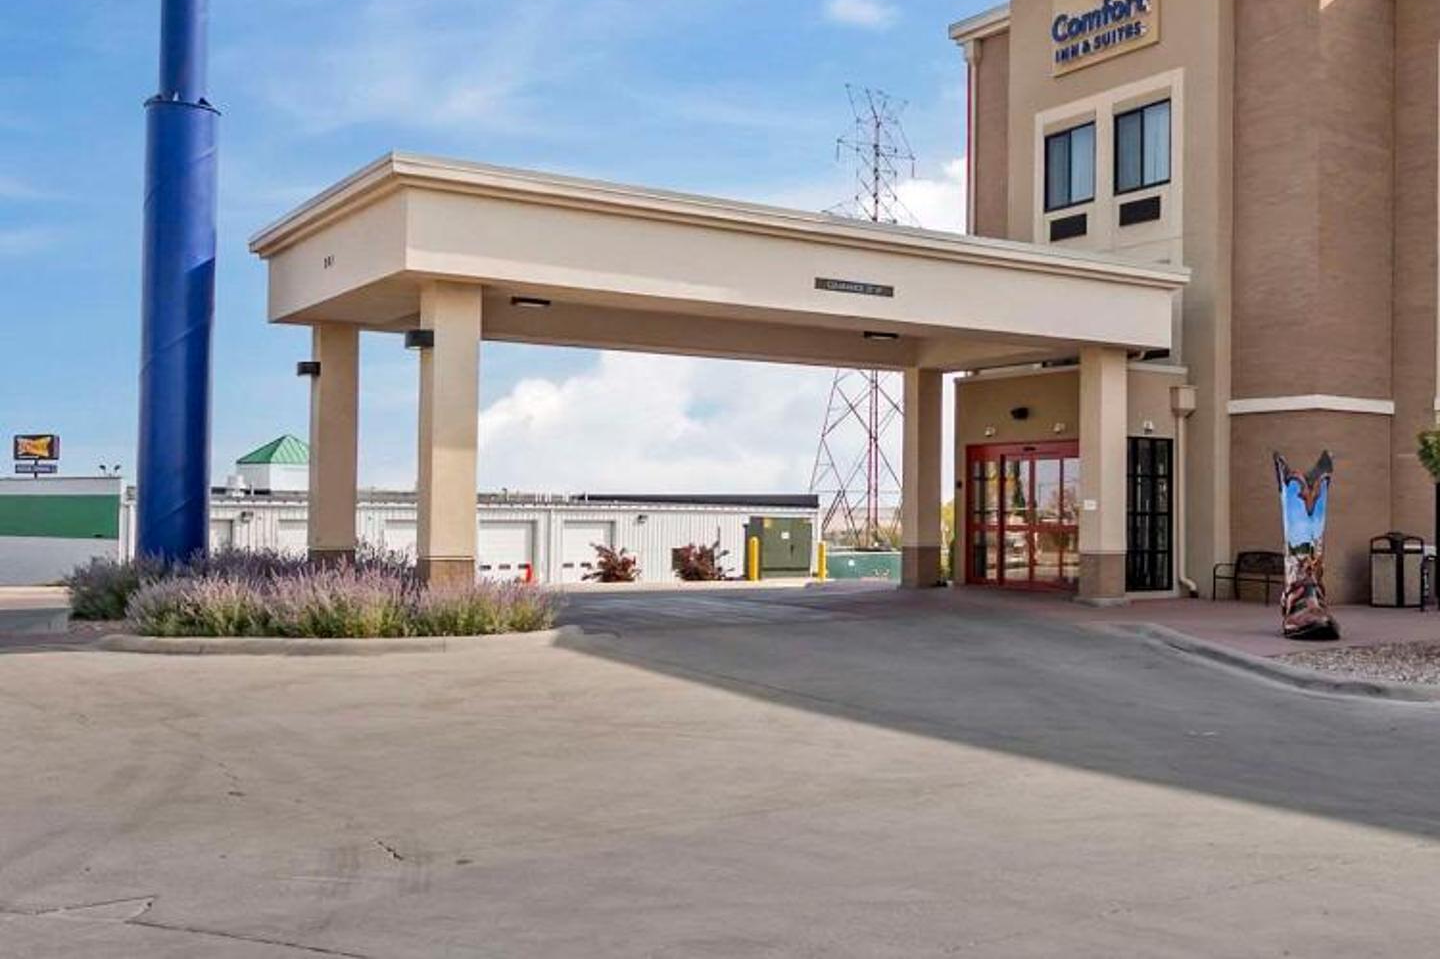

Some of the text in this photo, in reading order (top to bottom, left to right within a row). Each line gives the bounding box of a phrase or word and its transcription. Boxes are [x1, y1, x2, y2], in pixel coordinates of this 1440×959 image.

[1055, 21, 1143, 63] INN & SUITES
